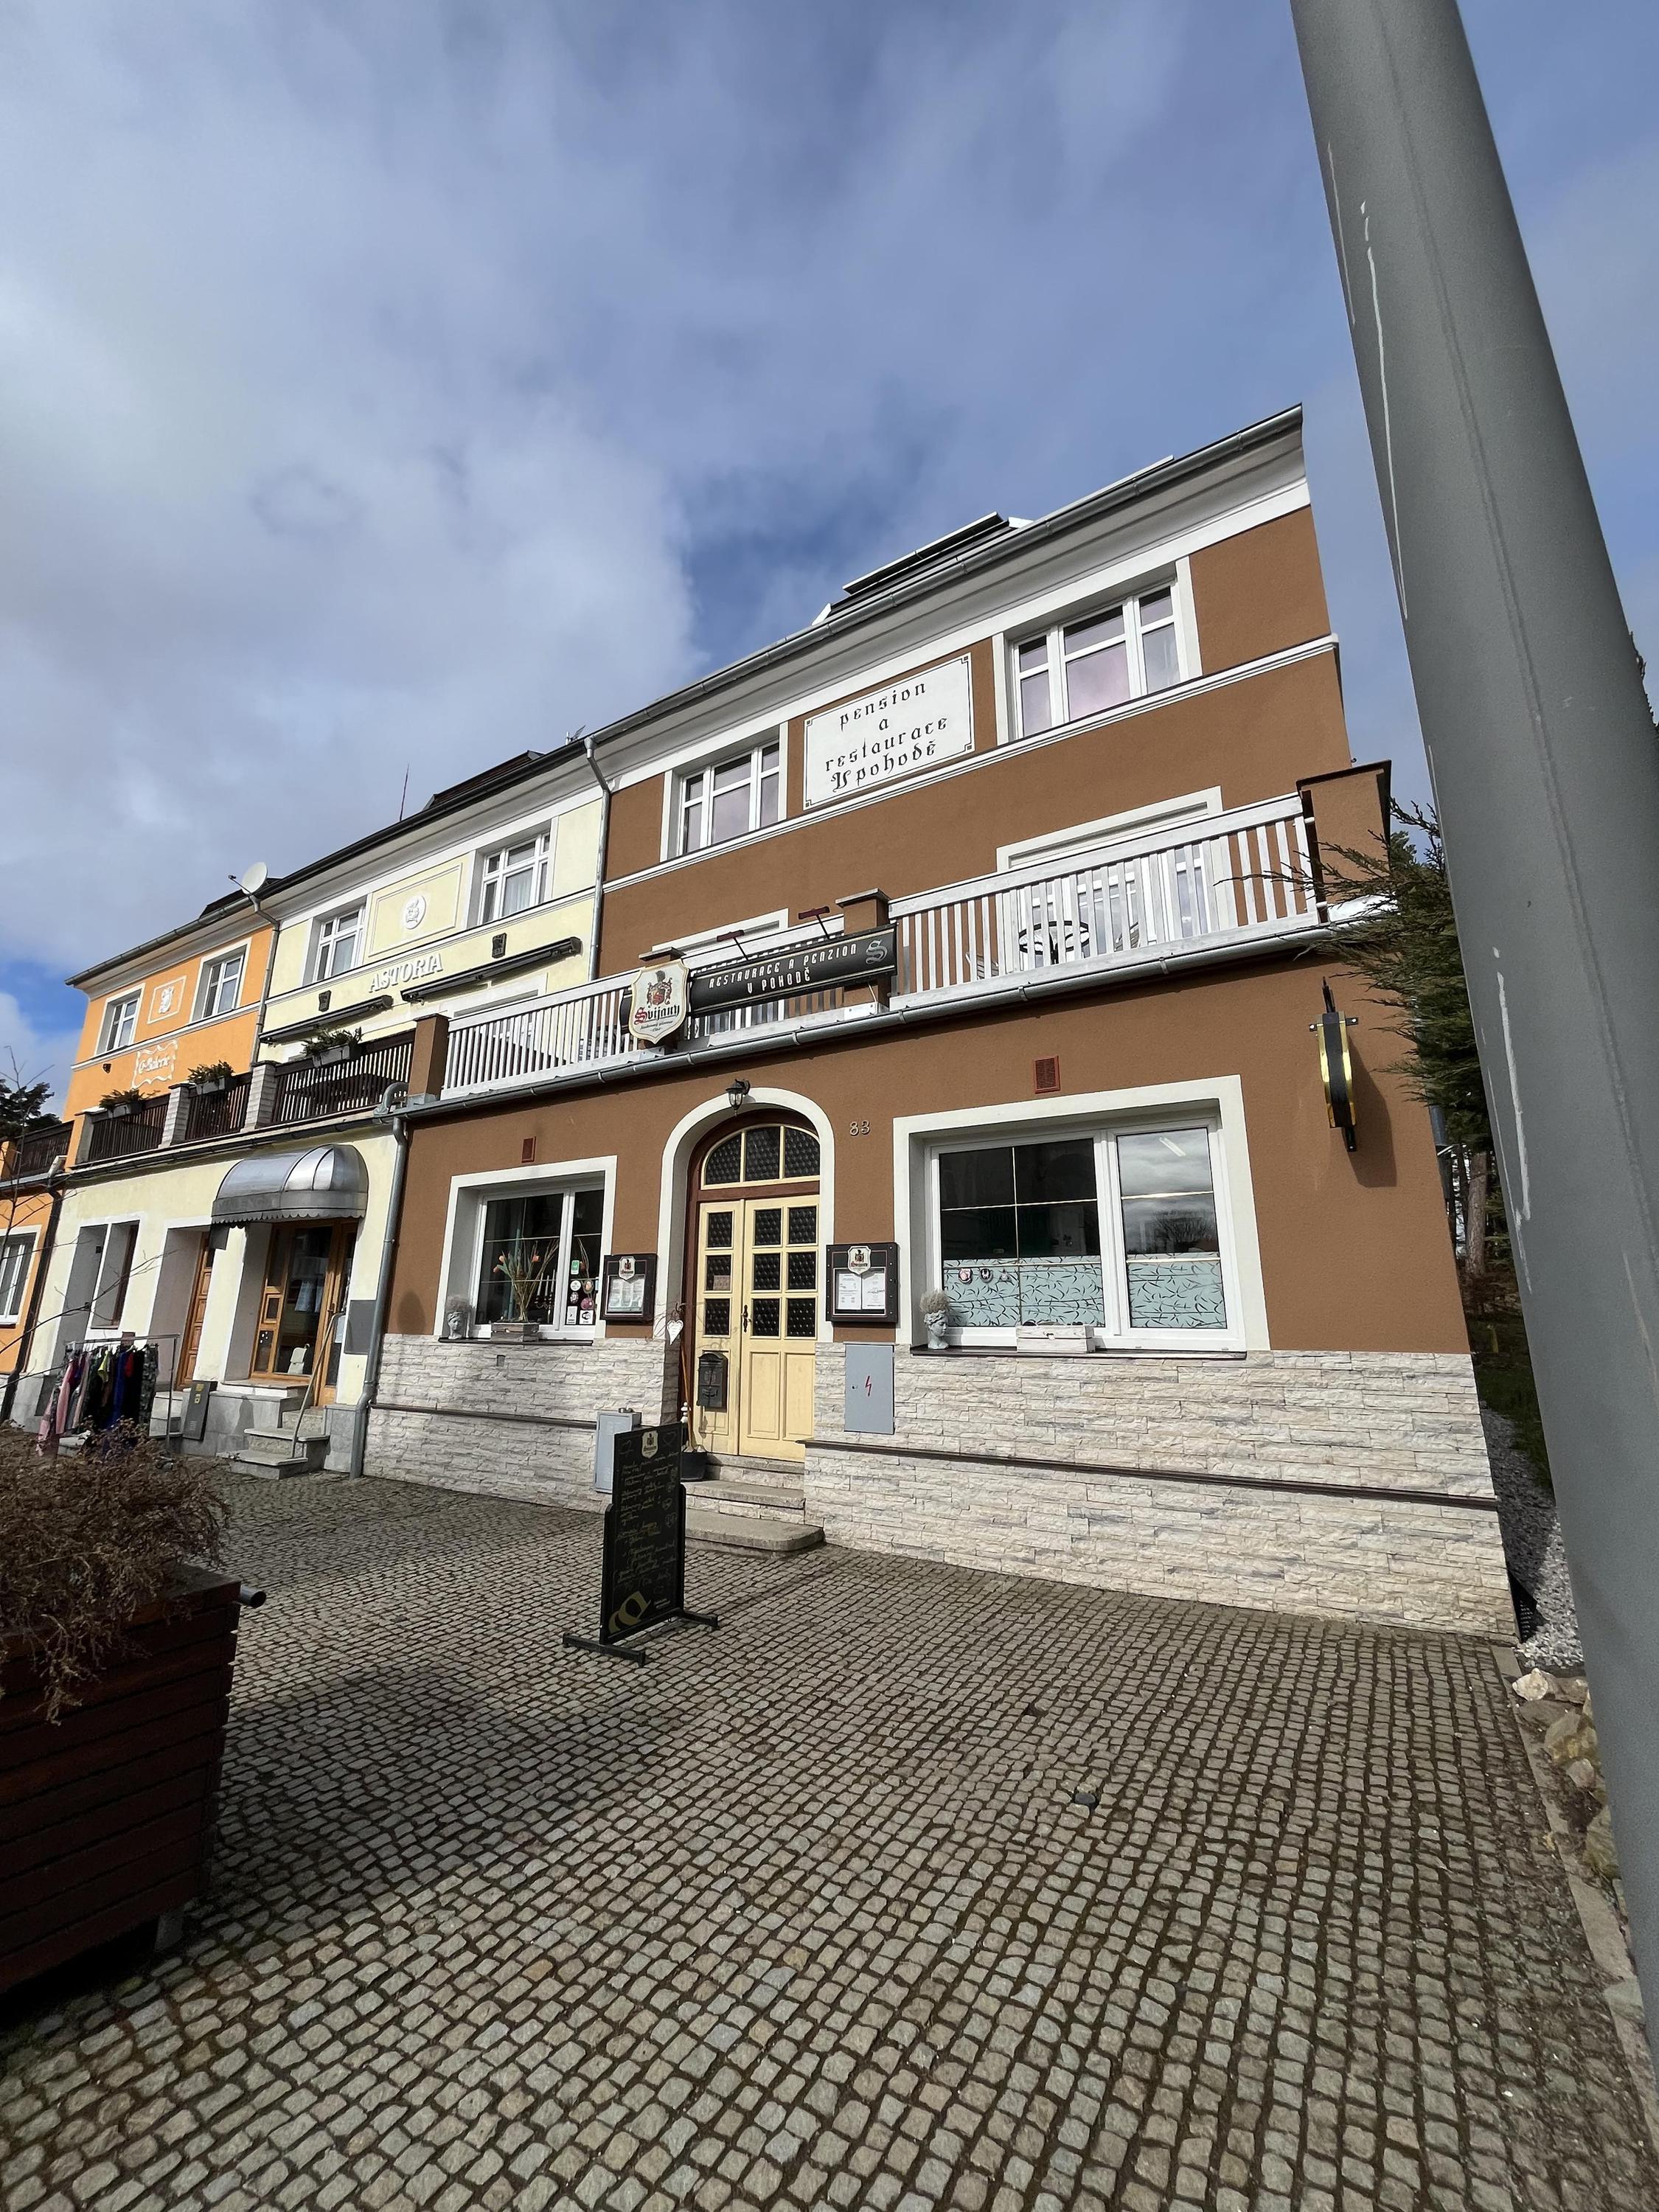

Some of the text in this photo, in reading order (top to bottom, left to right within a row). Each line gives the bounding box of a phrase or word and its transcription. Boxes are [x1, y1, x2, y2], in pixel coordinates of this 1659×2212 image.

[839, 682, 926, 732] pension
[878, 717, 889, 731] a
[825, 717, 947, 772] restaurace
[368, 953, 443, 993] ASTORIA
[709, 943, 858, 989] RESTAURACE A PENZION
[761, 967, 811, 991] POHODĚ
[633, 1004, 680, 1025] Svijany
[849, 1120, 871, 1136] 83
